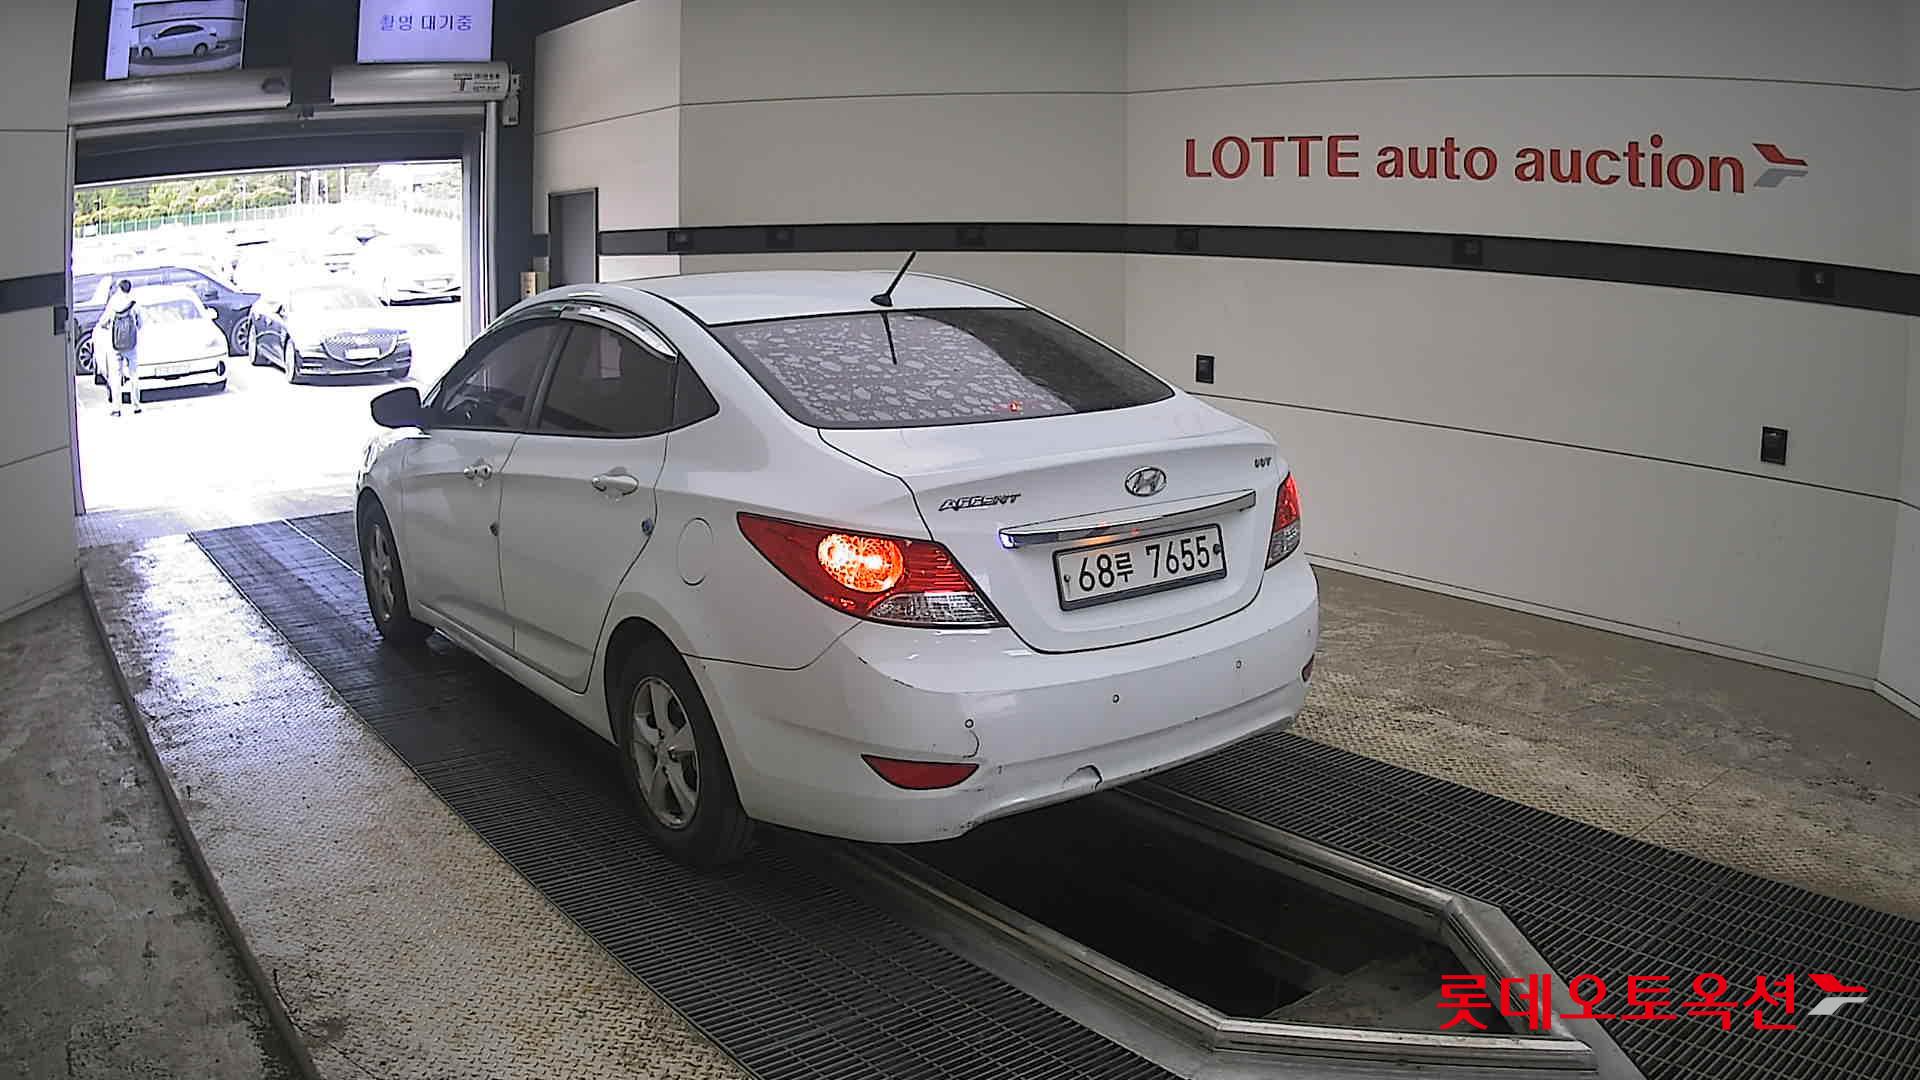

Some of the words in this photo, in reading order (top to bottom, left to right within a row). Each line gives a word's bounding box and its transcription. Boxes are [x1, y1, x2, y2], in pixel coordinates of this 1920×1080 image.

[421, 14, 473, 32] 대기중
[1185, 135, 1360, 179] LOTTE
[1376, 138, 1498, 180] auto
[1515, 135, 1746, 193] auction
[1078, 552, 1135, 592] 68루
[1145, 535, 1211, 578] 7655
